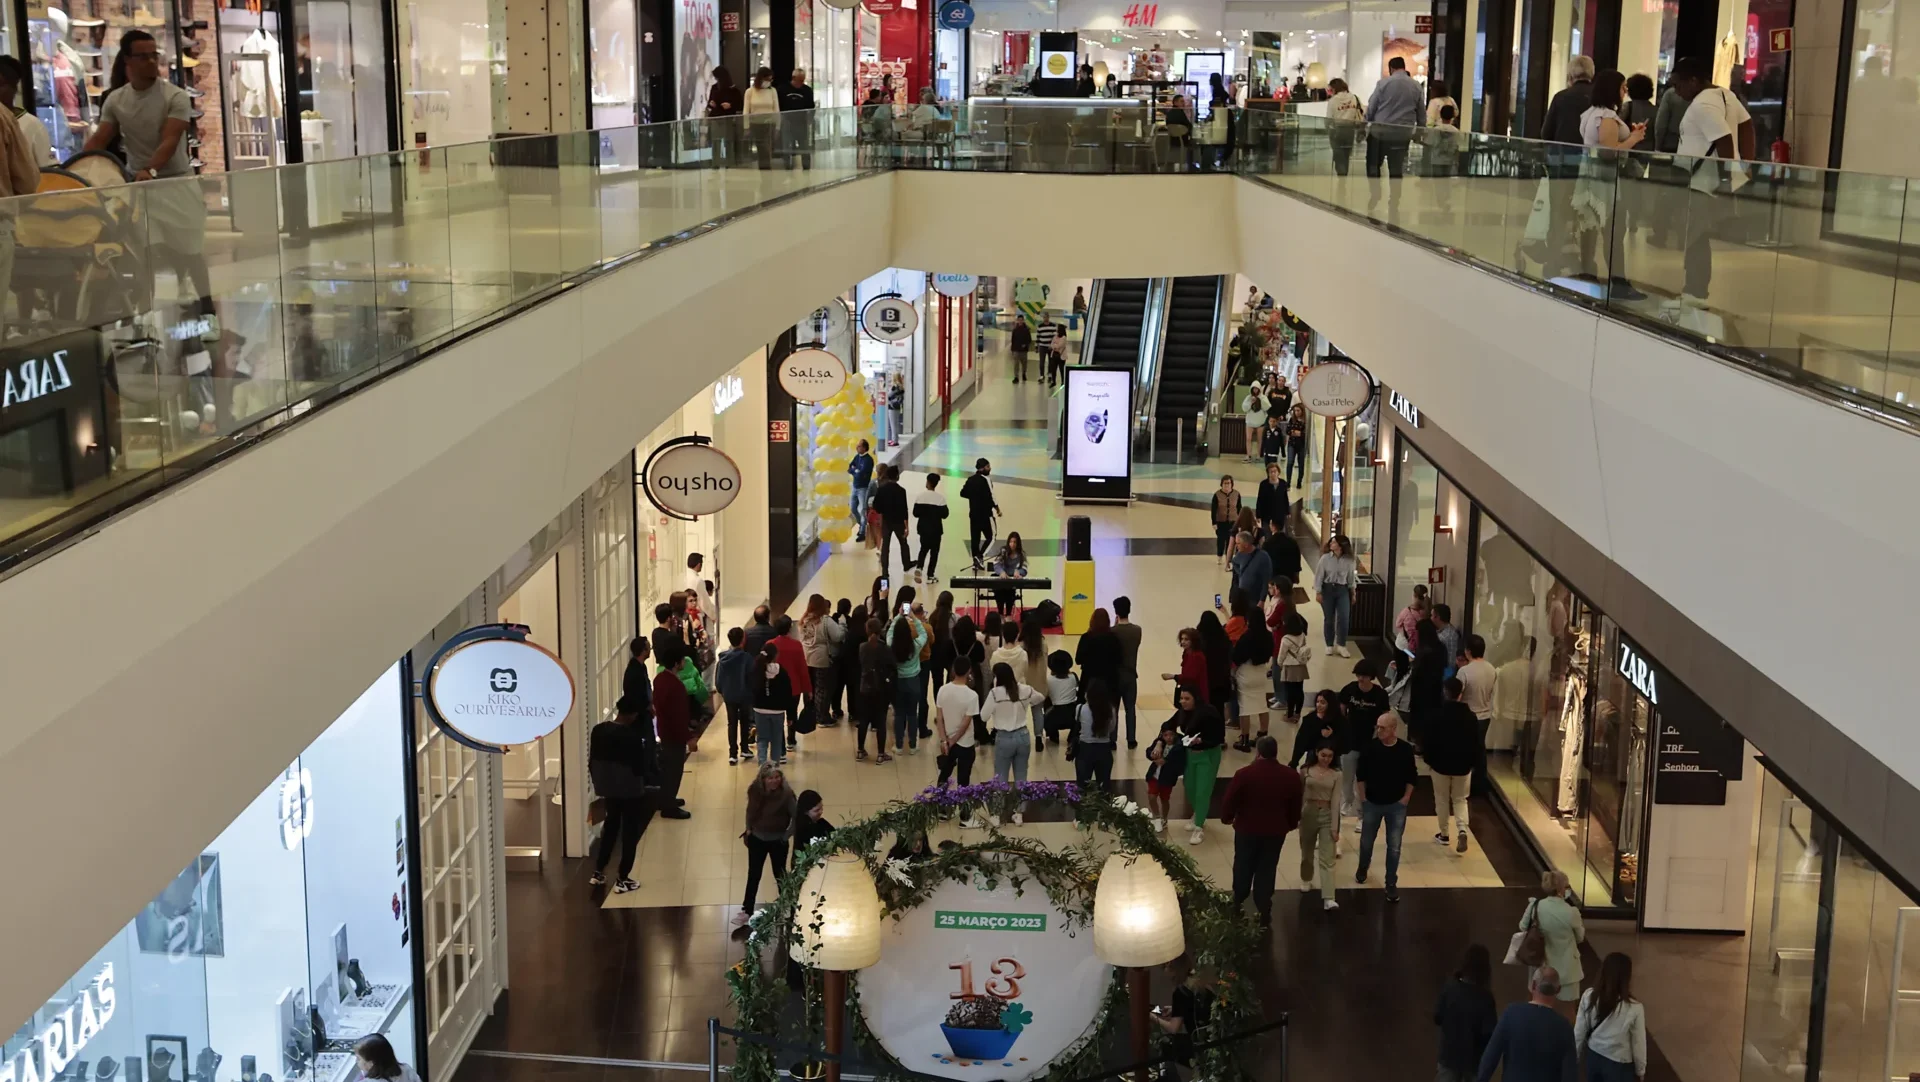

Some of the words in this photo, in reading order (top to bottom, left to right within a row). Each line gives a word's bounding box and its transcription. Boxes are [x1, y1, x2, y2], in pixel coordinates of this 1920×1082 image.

[684, 1, 713, 39] TOUS
[1122, 4, 1158, 28] H&M
[1312, 398, 1330, 406] Casa
[1335, 398, 1355, 406] Peles
[658, 472, 733, 496] oysho
[1620, 642, 1658, 705] ZARA
[487, 693, 521, 705] KIKO
[454, 703, 556, 718] OURIVESARIAS
[1664, 763, 1699, 771] Senhora
[940, 915, 955, 925] 25
[958, 916, 1007, 929] MARÇO
[1010, 917, 1041, 928] 2023
[949, 958, 1027, 1002] 13
